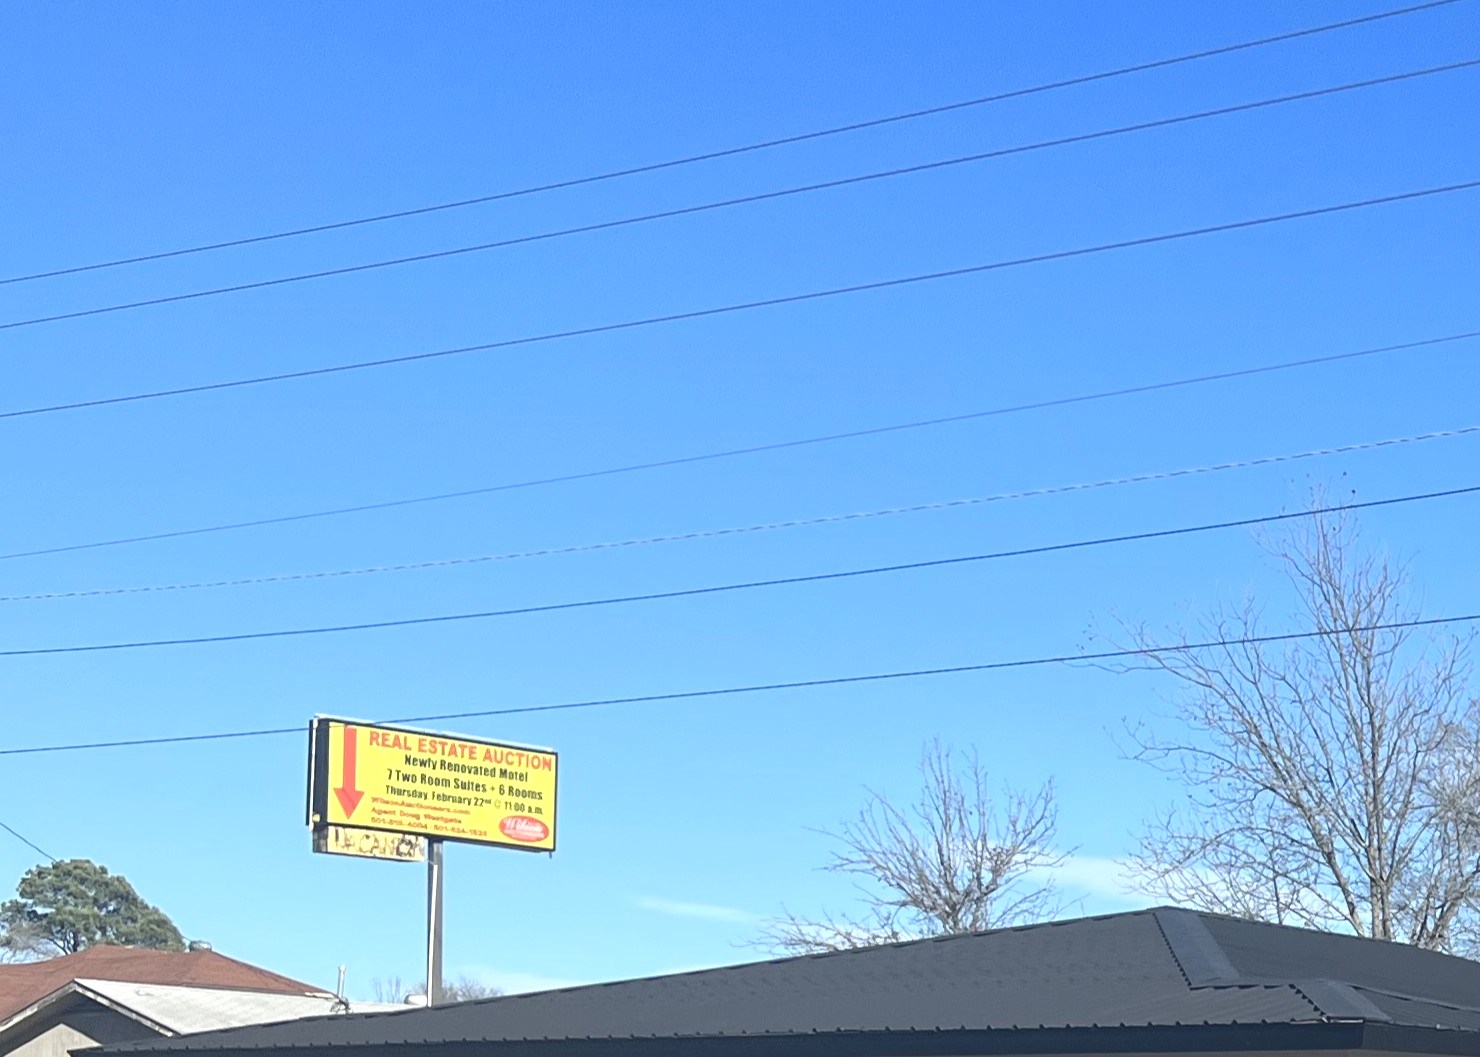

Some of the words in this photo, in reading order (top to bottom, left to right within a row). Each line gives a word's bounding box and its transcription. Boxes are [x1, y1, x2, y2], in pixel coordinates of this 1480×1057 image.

[369, 730, 412, 751] REAL
[418, 737, 477, 761] ESTATE
[483, 748, 552, 772] AUCTION
[404, 754, 437, 770] Newly
[440, 759, 496, 778] Renovated
[499, 768, 528, 782] Motel
[387, 768, 393, 781] 7
[395, 769, 417, 784] Two
[420, 773, 451, 788] Room
[453, 778, 487, 793] Suites
[499, 784, 506, 796] 6
[508, 785, 543, 801] Rooms
[432, 792, 472, 806] February
